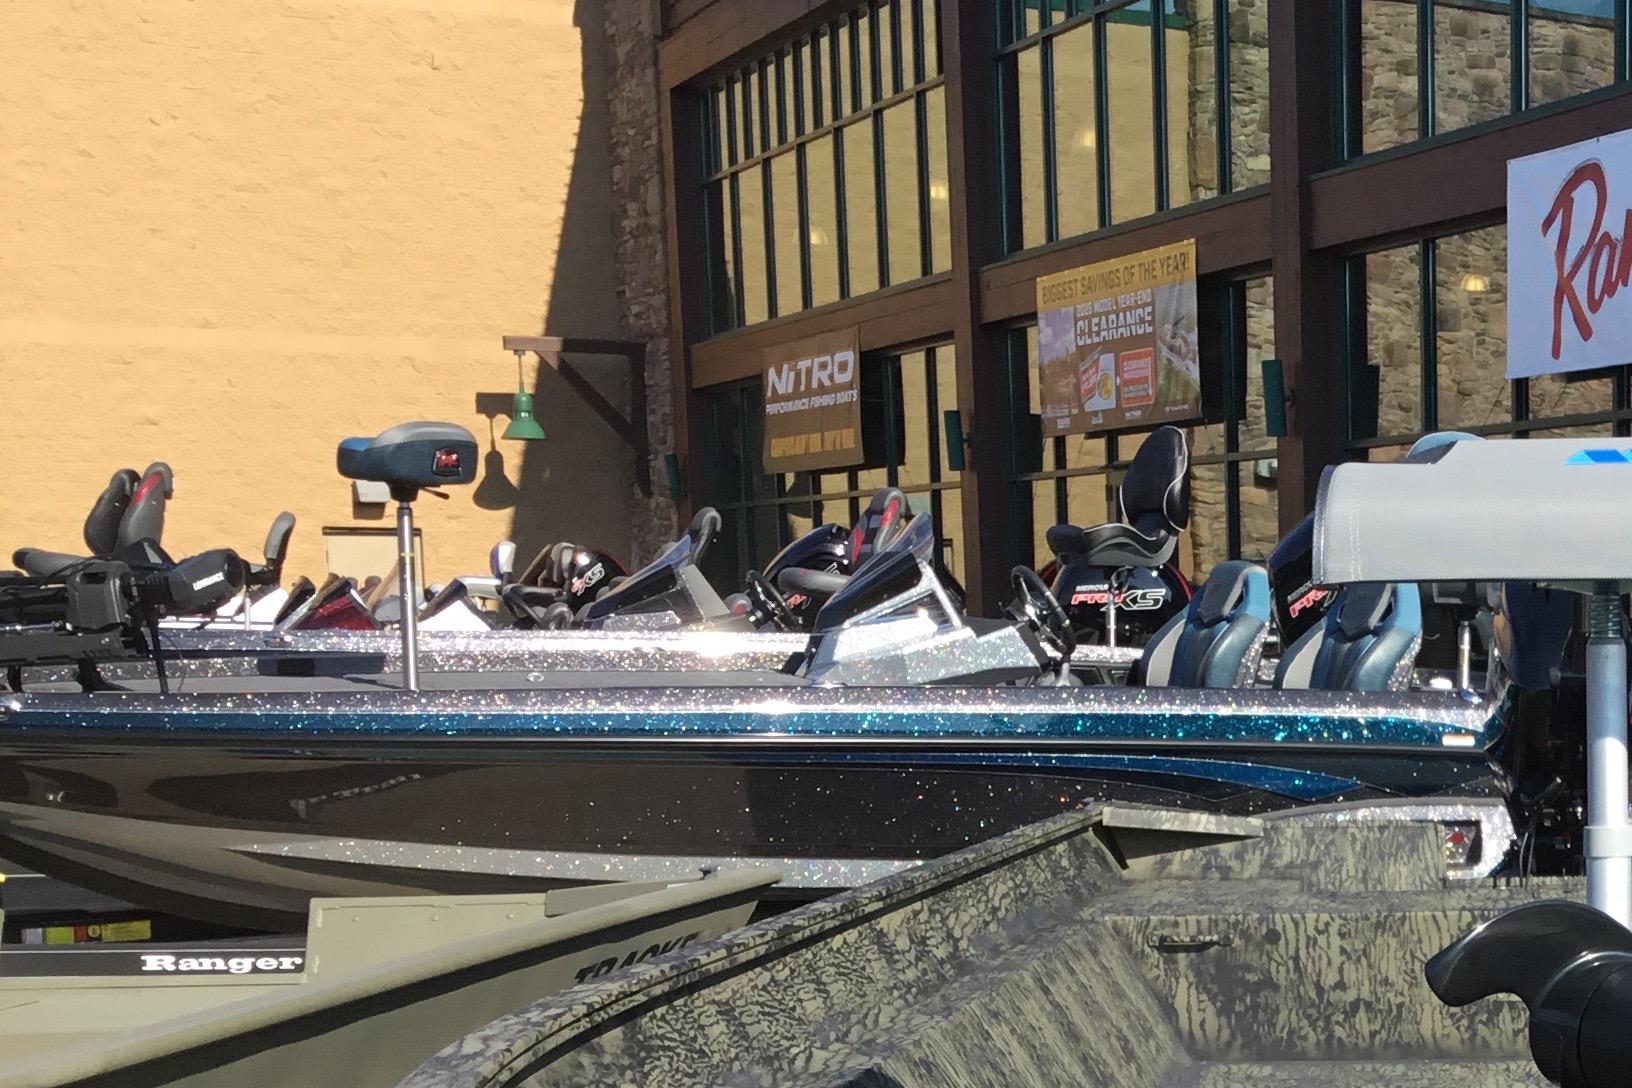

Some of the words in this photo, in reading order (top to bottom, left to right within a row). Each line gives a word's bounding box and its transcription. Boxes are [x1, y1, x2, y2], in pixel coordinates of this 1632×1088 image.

[1041, 279, 1079, 305] BIGGEST
[1079, 267, 1121, 296] SAVINGS
[1122, 265, 1137, 286] OF
[1137, 259, 1158, 282] THE
[1158, 250, 1190, 275] YEAR!
[1076, 306, 1153, 346] CLEARANCE
[140, 954, 303, 974] Ranger
